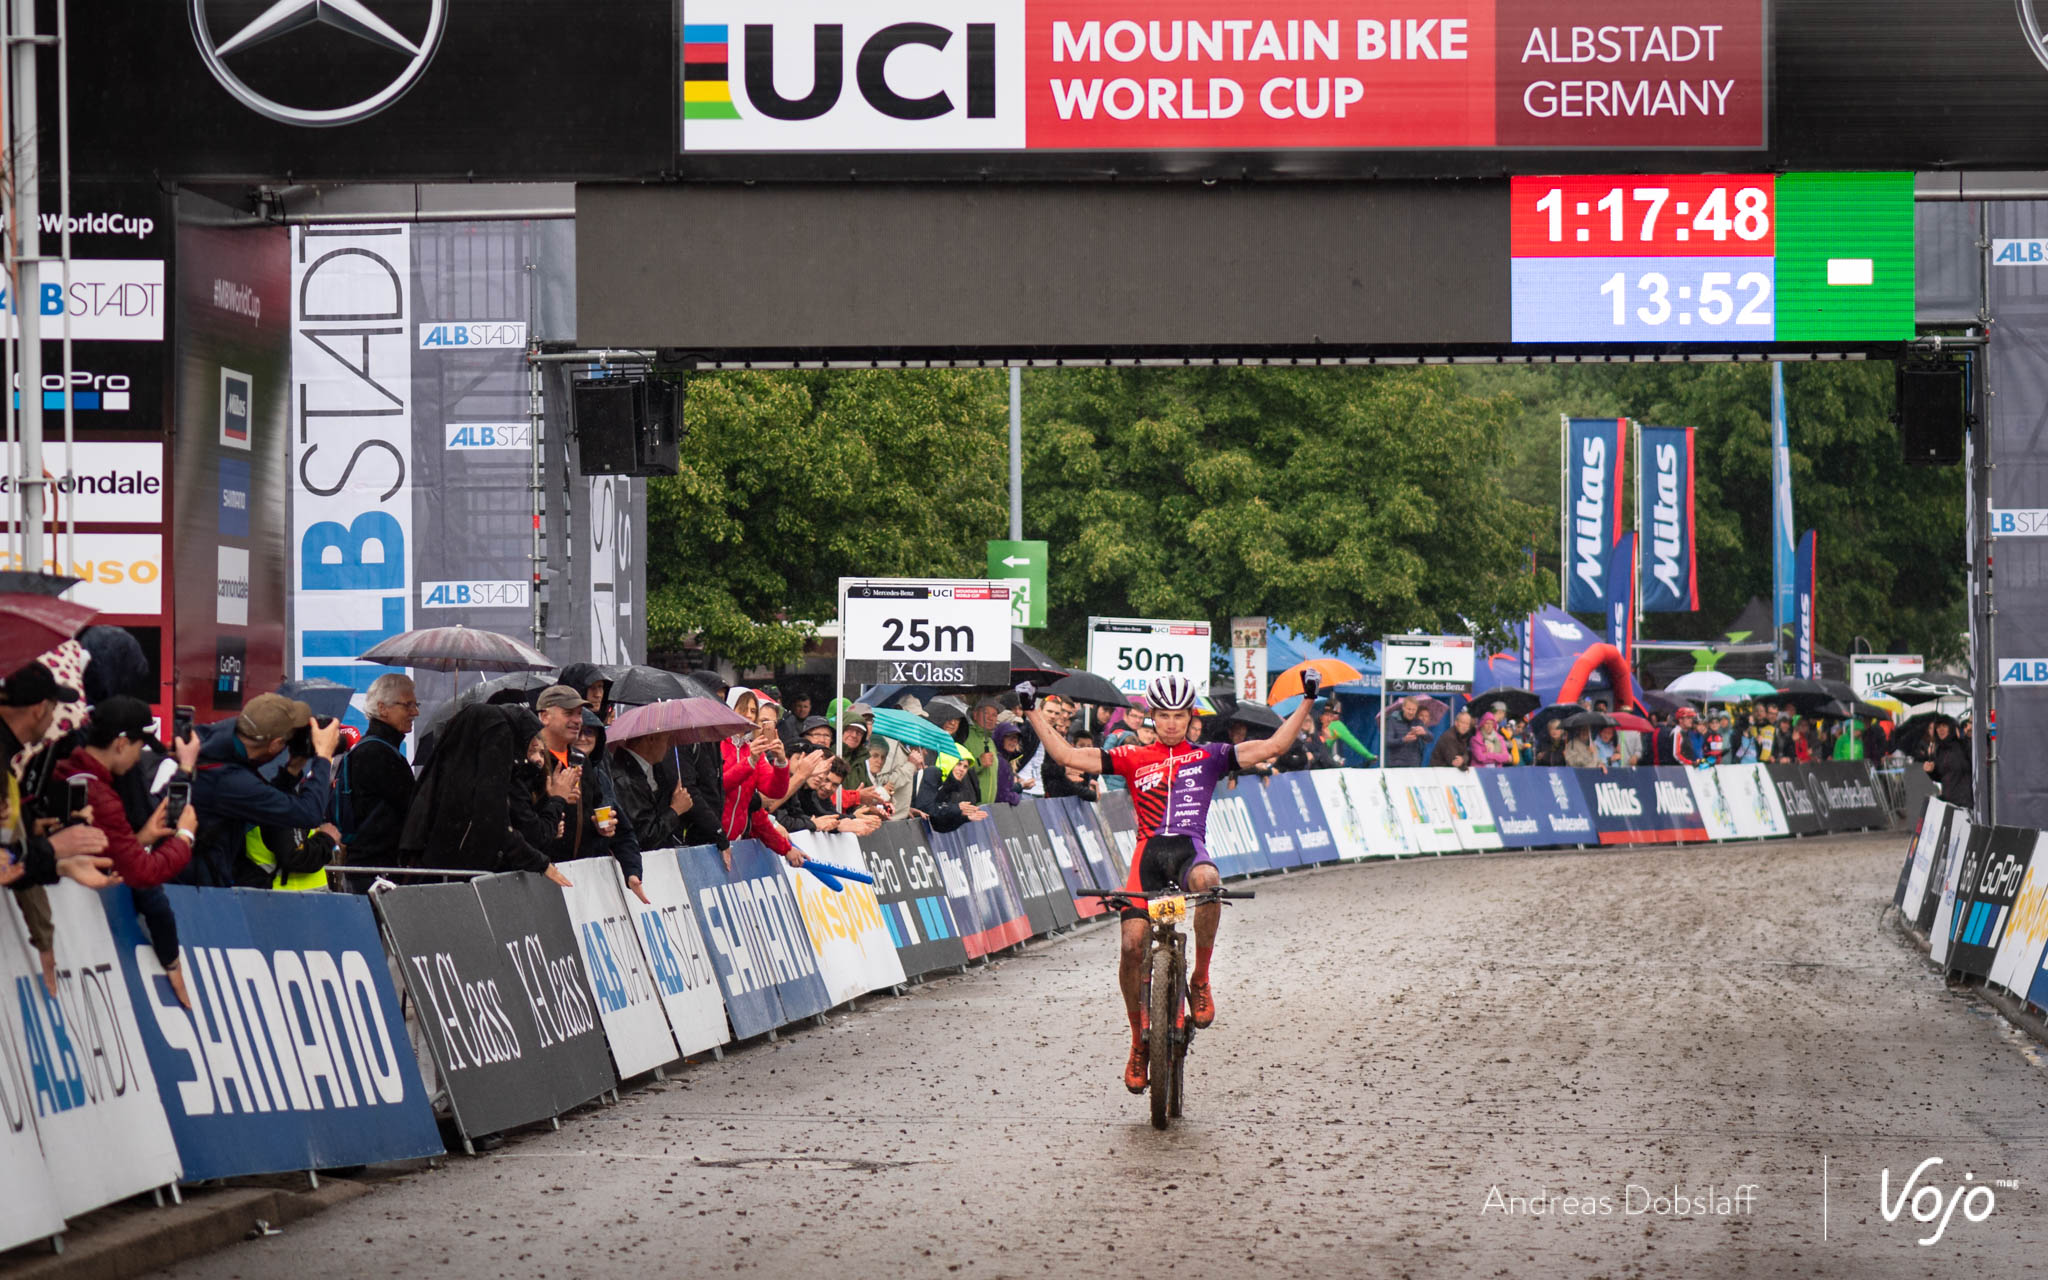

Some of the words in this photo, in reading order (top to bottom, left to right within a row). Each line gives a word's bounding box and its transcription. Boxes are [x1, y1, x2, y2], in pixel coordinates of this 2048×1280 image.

[1051, 20, 1339, 62] MOUNTAIN
[1356, 18, 1468, 60] BIKE
[1521, 25, 1723, 63] ALBSTADT
[744, 22, 996, 121] UCI
[1050, 78, 1244, 120] WORLD
[1259, 77, 1364, 119] CUP
[1523, 79, 1735, 118] GERMANY
[0, 213, 154, 239] WorldCup
[1536, 187, 1770, 242] 1:17:48
[0, 282, 162, 317] BSTADT
[1600, 272, 1771, 326] 13:52
[423, 325, 525, 347] ALBSTADT
[14, 371, 130, 390] oPro
[1576, 436, 1605, 598] Mitas
[1653, 444, 1681, 598] Mitas
[424, 583, 527, 605] ALBSTADT
[933, 589, 952, 598] UCI
[882, 618, 974, 652] 25m
[891, 662, 964, 682] X-Class
[1117, 647, 1184, 672] 50m
[1405, 657, 1453, 675] 75m
[1407, 682, 1465, 691] Mercedes-Benz
[1595, 782, 1643, 817] Mitas
[1654, 781, 1694, 815] Mitas
[1979, 852, 2023, 898] GoPro
[1158, 900, 1176, 916] 29
[700, 876, 817, 997] SHIMANO
[411, 952, 522, 1071] X-Class
[506, 933, 594, 1048] X-Class
[16, 963, 140, 1118] ALBSTADT
[135, 944, 404, 1117] SHIMANO
